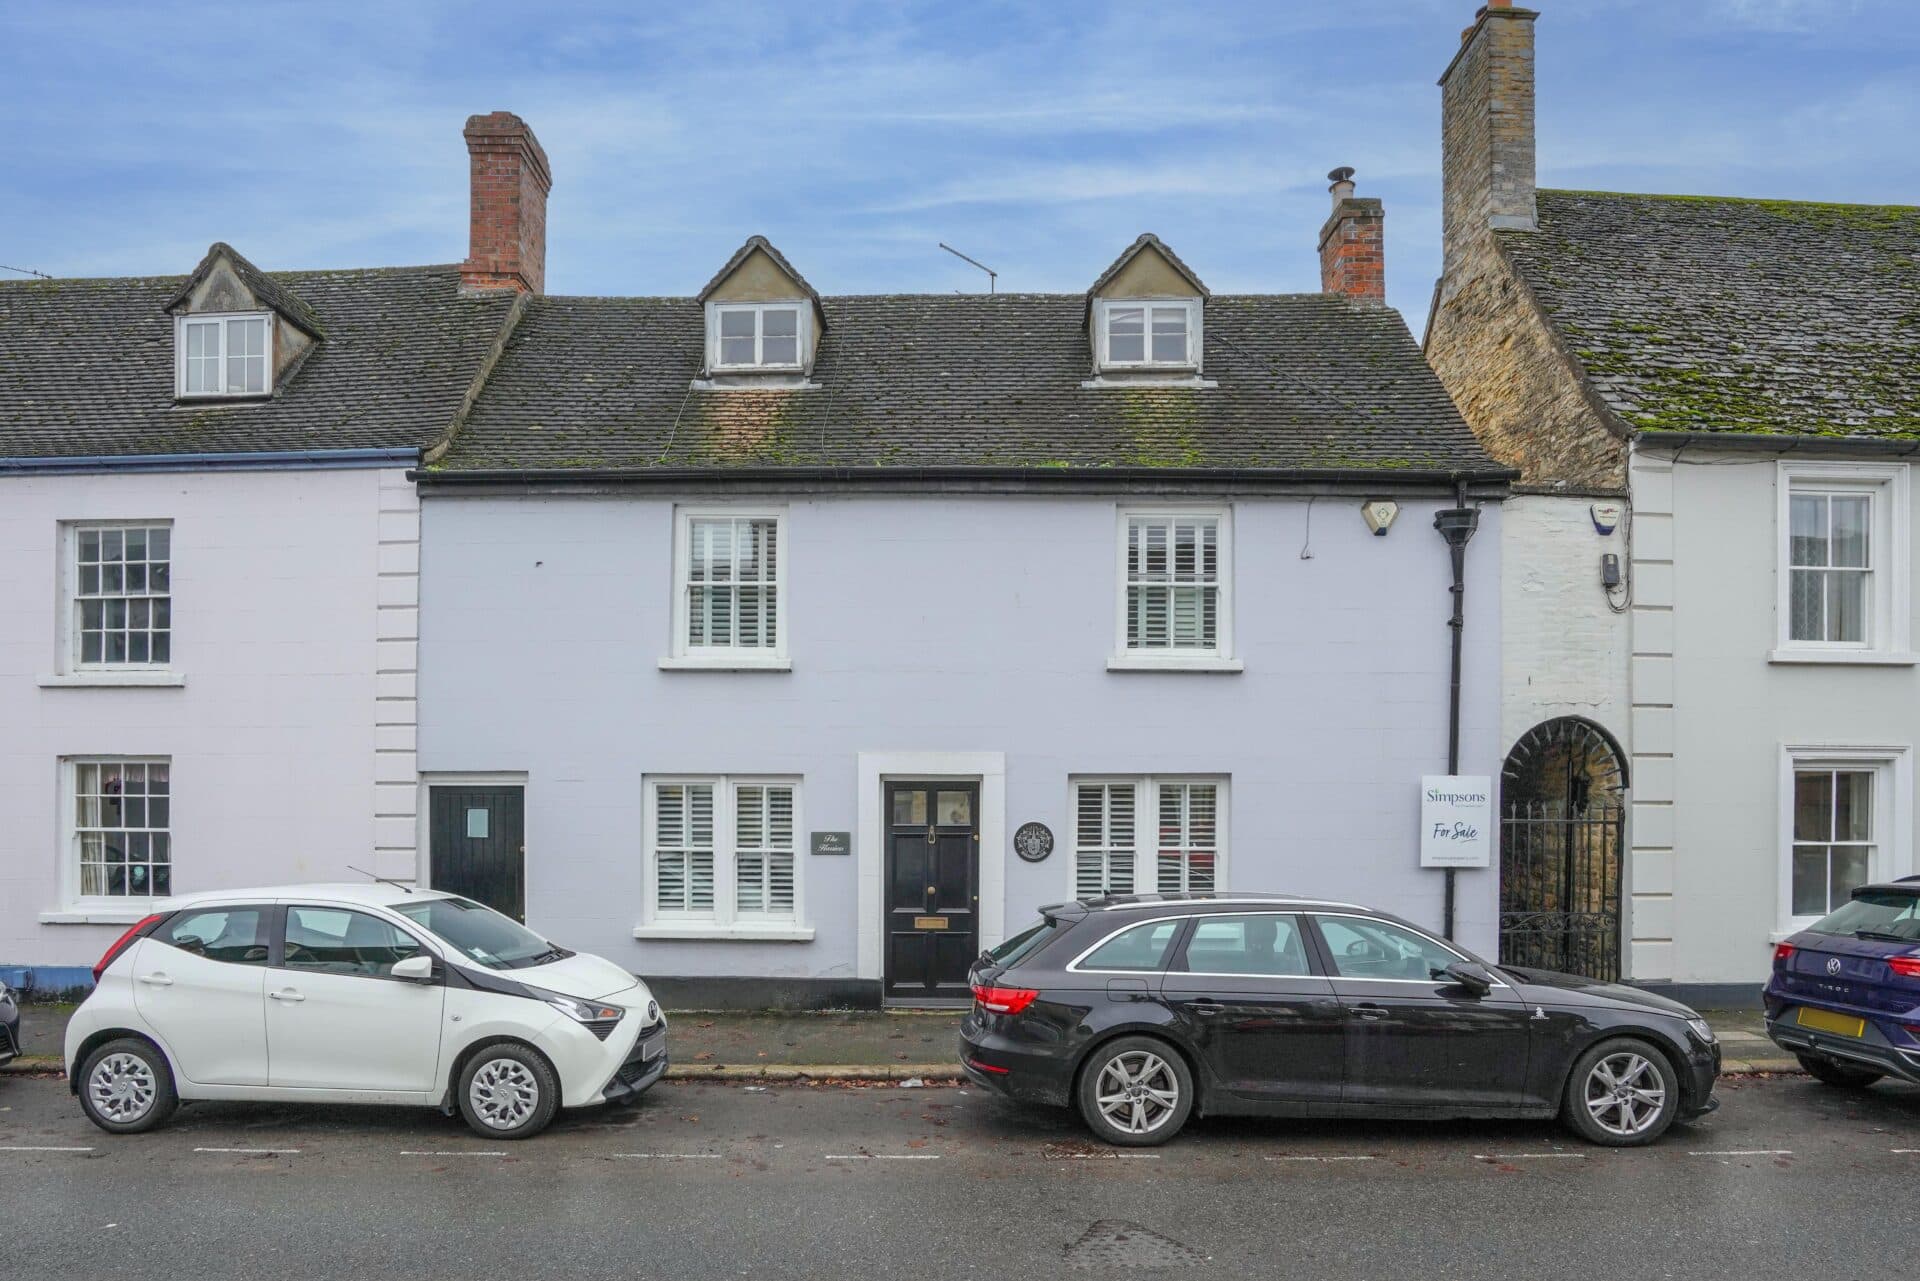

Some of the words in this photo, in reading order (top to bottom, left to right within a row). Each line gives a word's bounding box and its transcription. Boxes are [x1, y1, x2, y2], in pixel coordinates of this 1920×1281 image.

[1427, 789, 1486, 806] Simpsons
[1433, 822, 1450, 839] For
[1451, 821, 1478, 840] Sale
